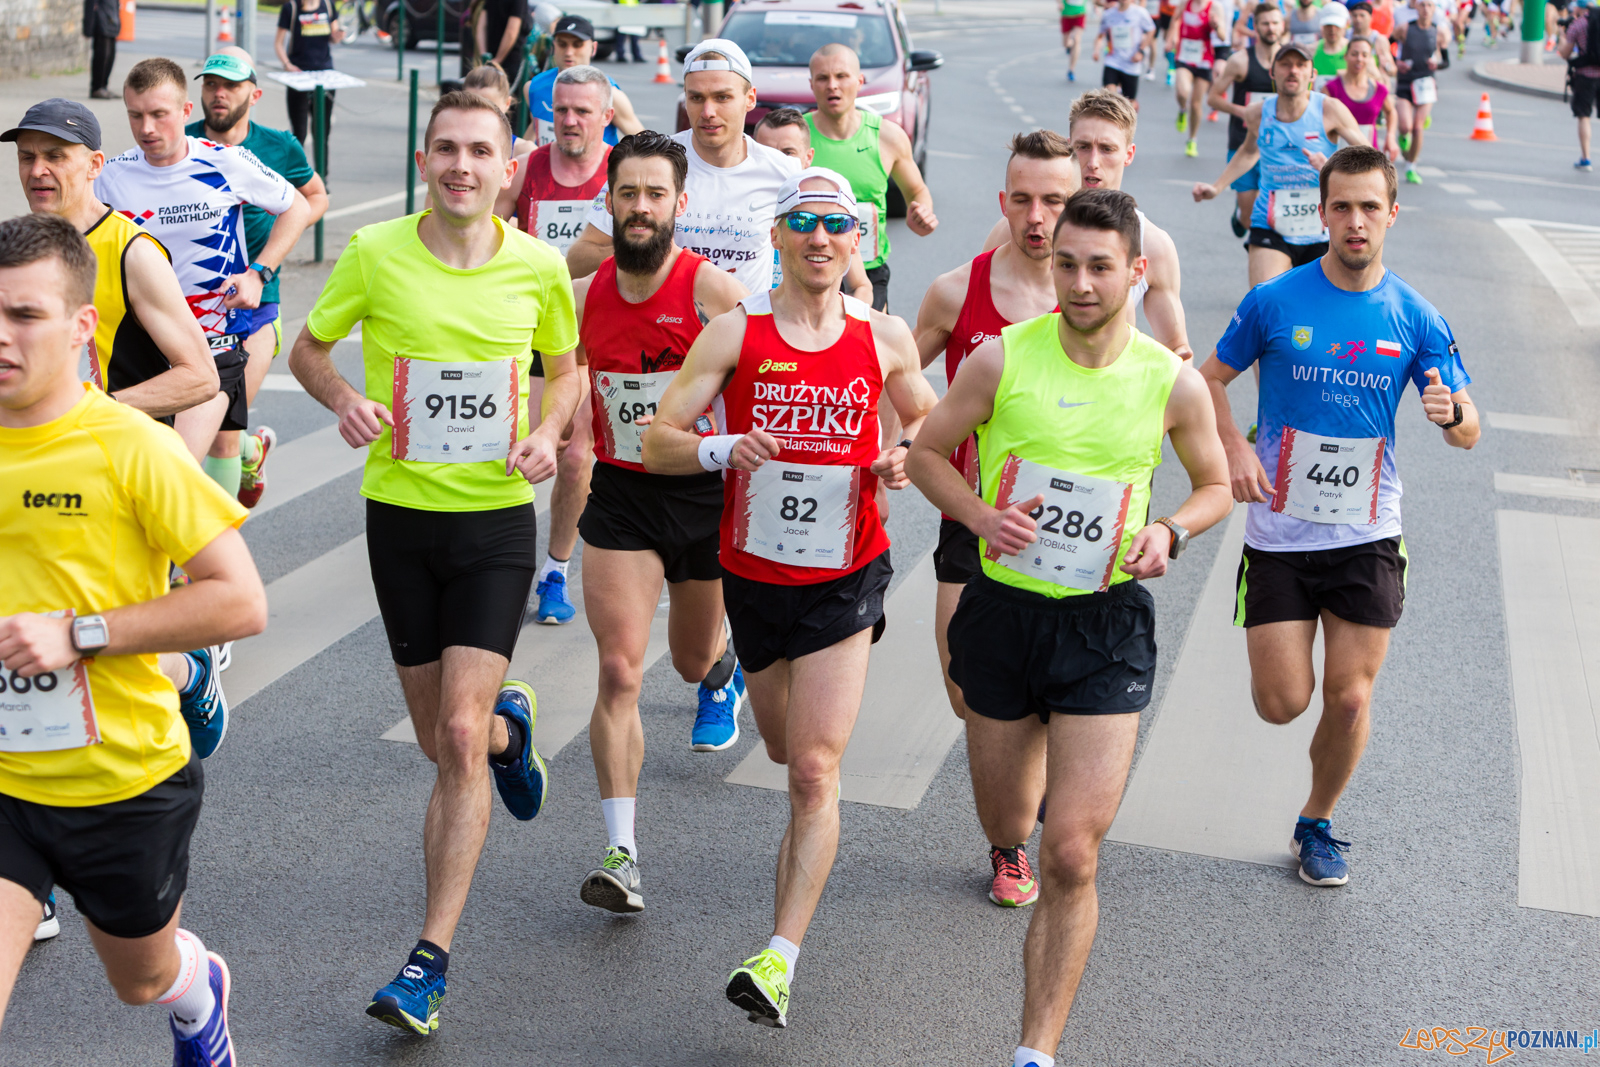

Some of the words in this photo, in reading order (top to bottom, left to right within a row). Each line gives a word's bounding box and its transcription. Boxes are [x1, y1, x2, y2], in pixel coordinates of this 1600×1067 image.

[158, 202, 210, 216] FABRYKA
[158, 208, 222, 225] TRIATHLONU
[687, 212, 753, 223] OŁECTWO
[1282, 203, 1317, 217] 3359
[682, 246, 757, 262] BROWSKI
[661, 314, 683, 324] asics
[766, 360, 798, 372] asics
[1292, 364, 1391, 391] WITKOWO
[753, 380, 853, 406] DRUŻYNA
[1321, 389, 1360, 407] biega
[425, 393, 497, 420] 9156
[618, 402, 660, 424] 681
[752, 404, 868, 436] SZPIKU
[446, 425, 475, 433] Dawid
[1306, 463, 1360, 487] 440
[23, 490, 82, 508] team
[1319, 490, 1343, 499] Patryk
[780, 495, 818, 523] 82
[783, 526, 810, 536] Jacek
[1039, 537, 1078, 554] TOBIASZ
